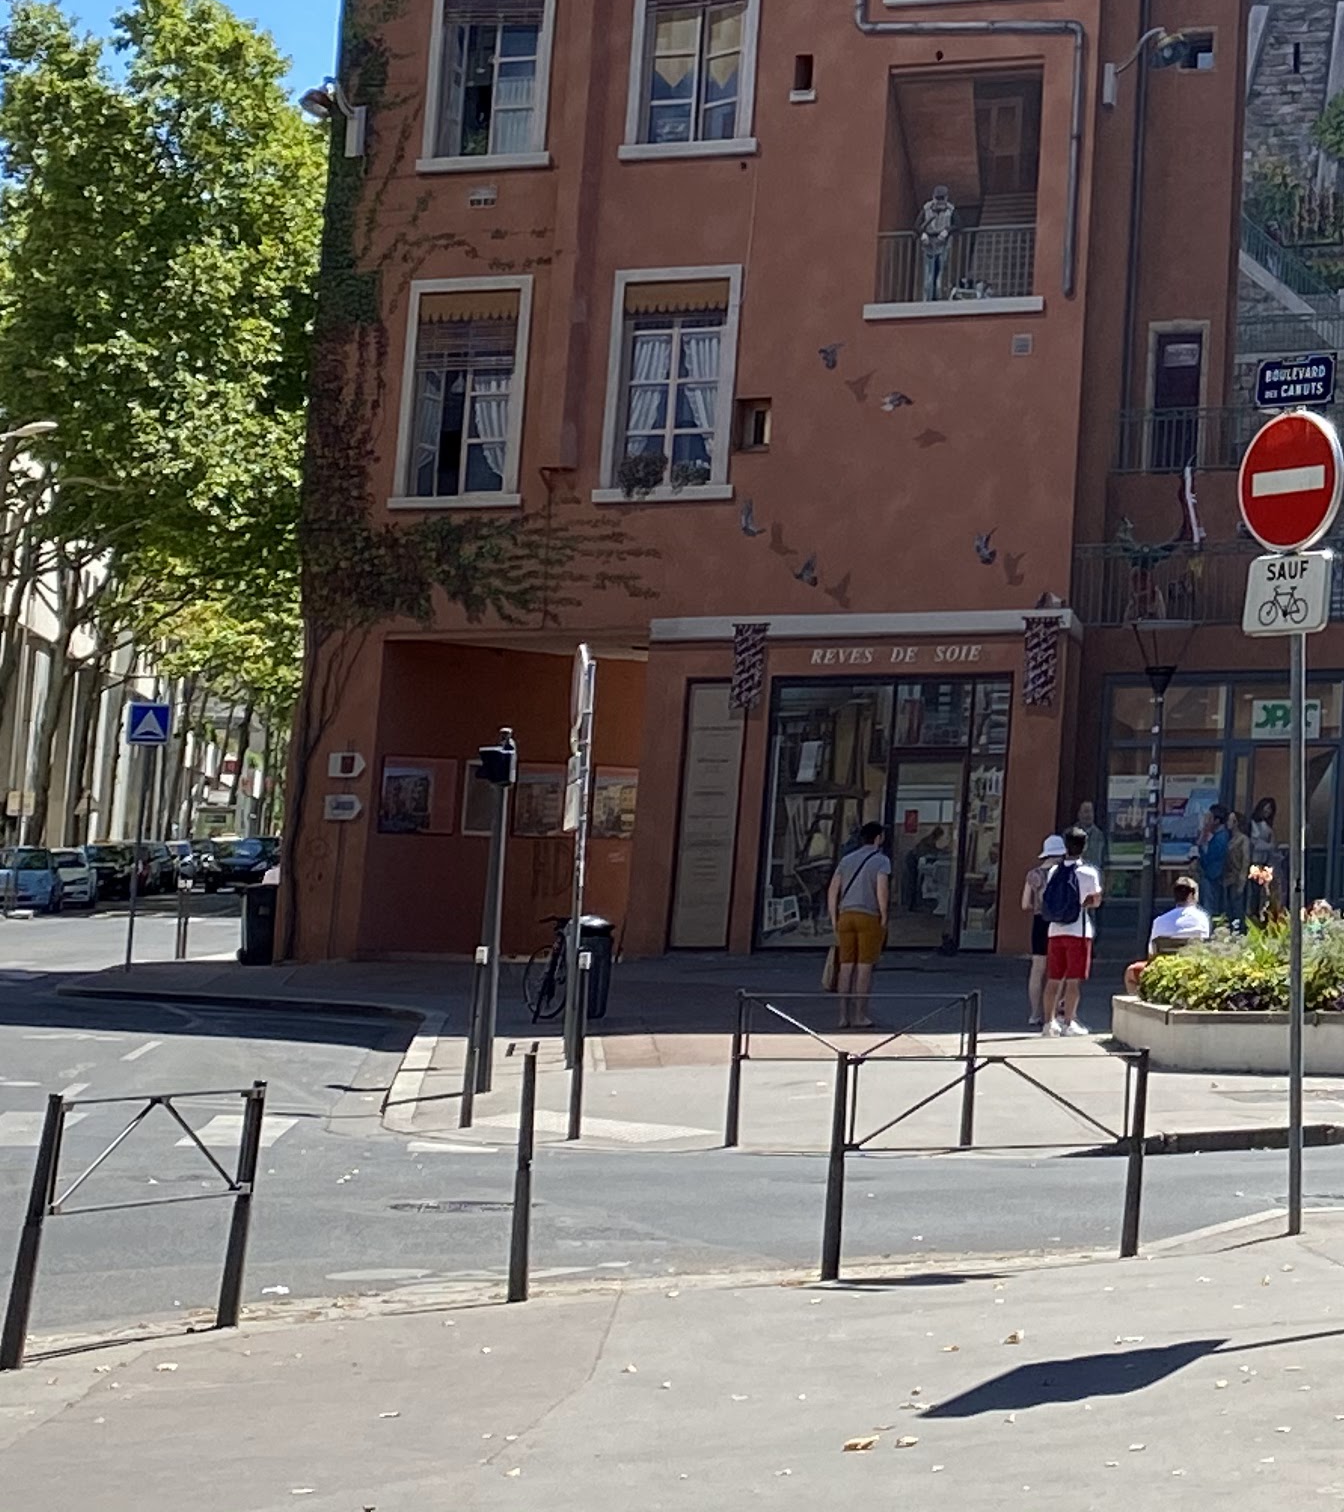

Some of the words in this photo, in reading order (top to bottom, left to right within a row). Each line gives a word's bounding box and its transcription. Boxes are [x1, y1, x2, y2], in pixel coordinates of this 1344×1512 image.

[1265, 364, 1326, 384] BOULEVARD
[1280, 382, 1324, 398] CANUTS
[1266, 560, 1309, 581] SAUF
[810, 647, 875, 665] REVES
[890, 646, 919, 663] DE
[933, 644, 983, 663] SOIE
